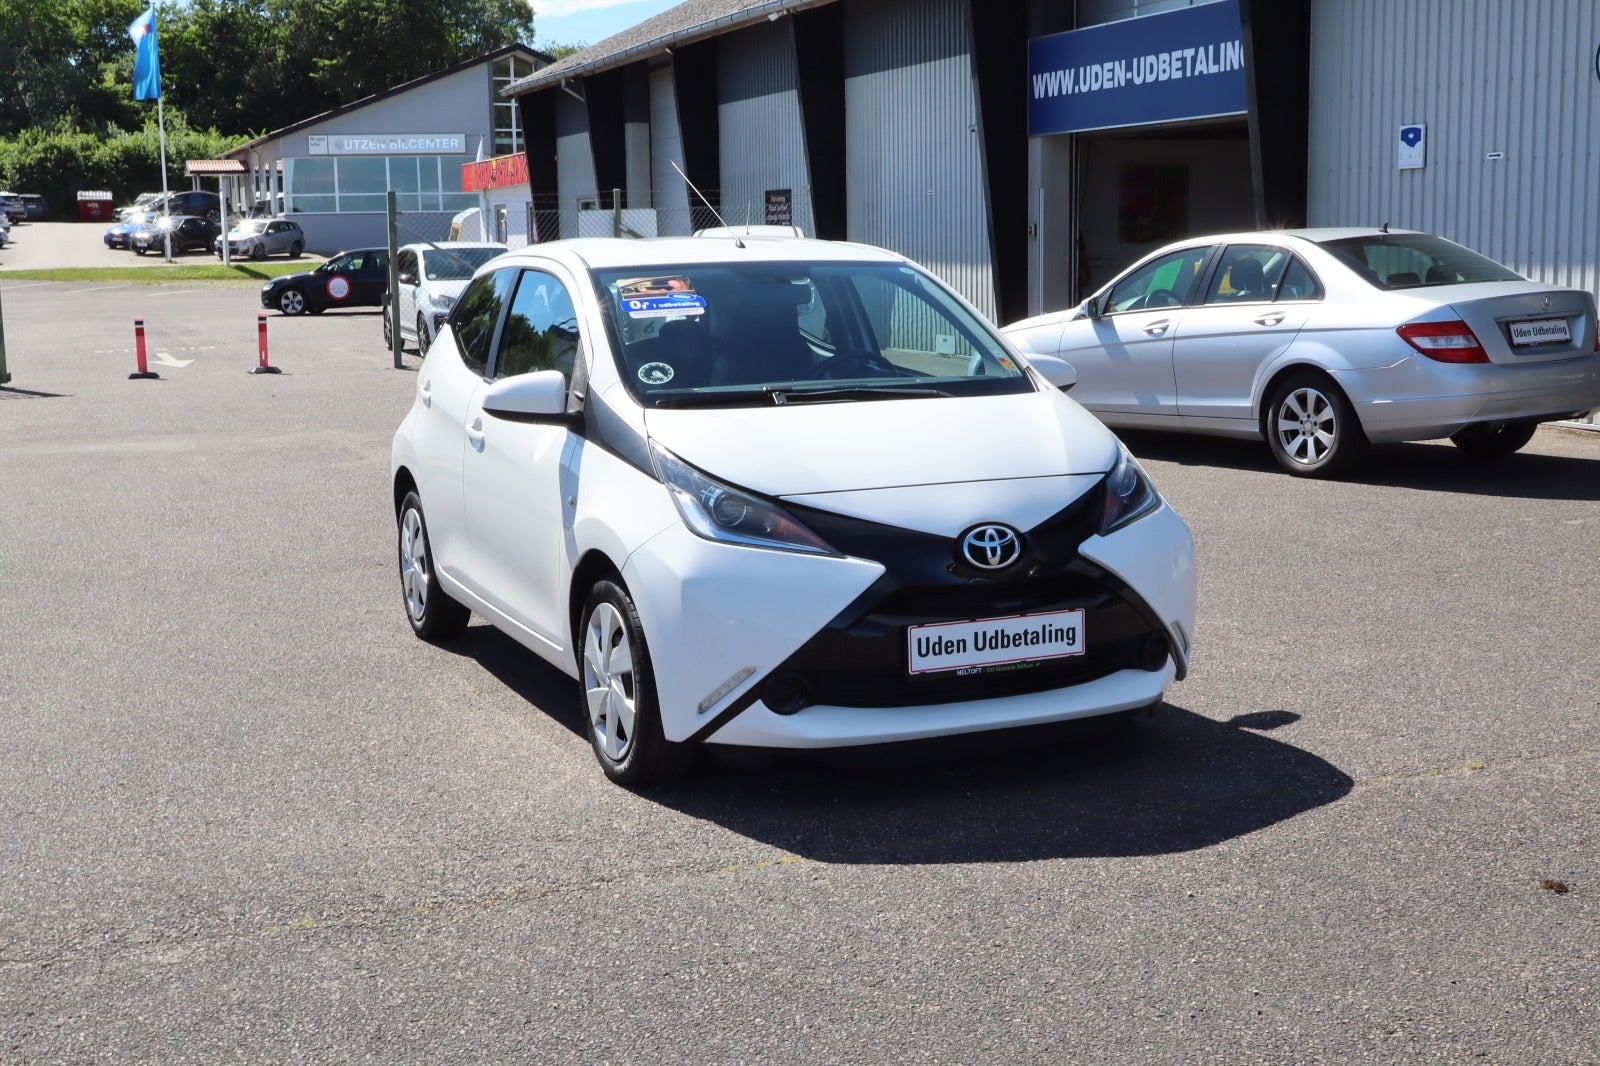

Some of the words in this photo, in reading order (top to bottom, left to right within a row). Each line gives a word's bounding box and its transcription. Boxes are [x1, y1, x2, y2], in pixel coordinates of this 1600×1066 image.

[1032, 39, 1244, 99] WWW.UDEN-UDBETALIN
[1513, 328, 1532, 338] Uden
[1532, 325, 1568, 337] Udbetaling
[916, 635, 967, 658] Uden
[973, 623, 1076, 652] Udbetaling
[956, 667, 982, 676] NELTOFT
